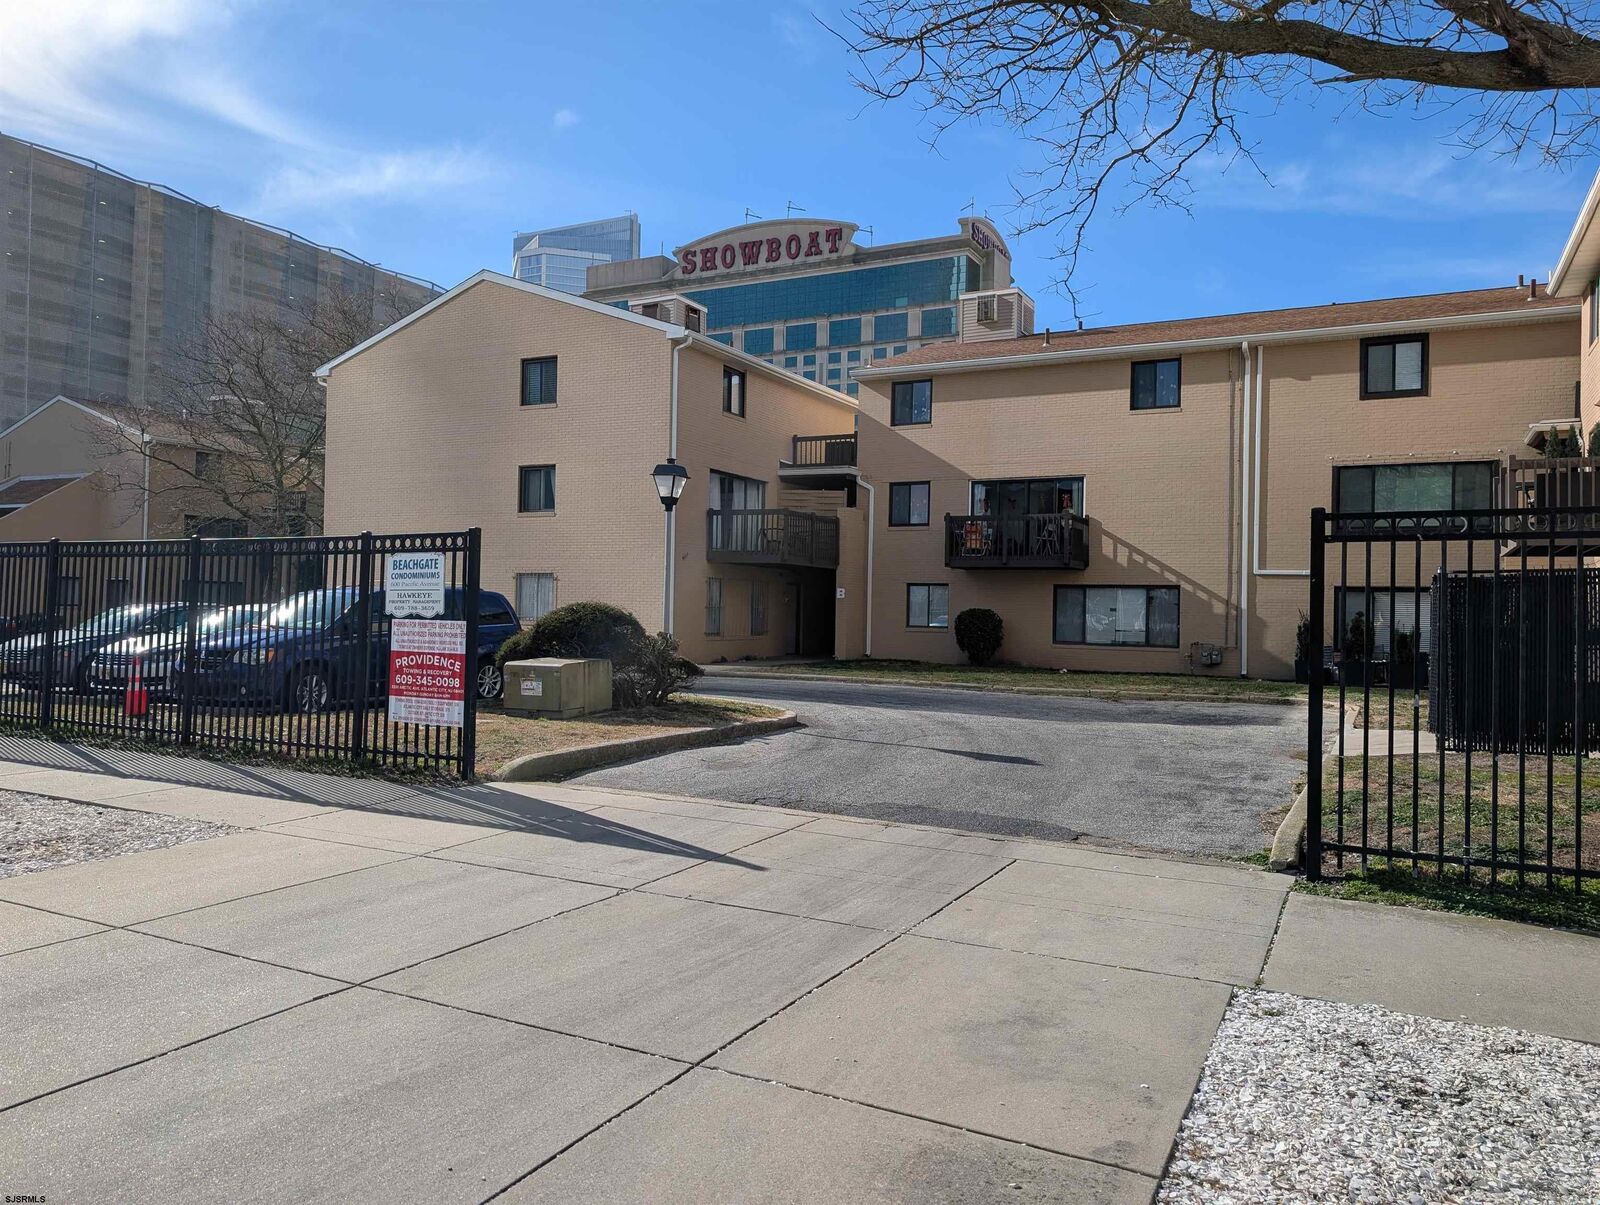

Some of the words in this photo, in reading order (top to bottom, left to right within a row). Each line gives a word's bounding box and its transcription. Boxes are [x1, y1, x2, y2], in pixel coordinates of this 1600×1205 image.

[682, 227, 843, 274] SHOWBOAT
[392, 558, 439, 571] BEACHGATE
[390, 571, 440, 580] CONDOMINIUMS
[395, 654, 462, 673] PROVIDENCE
[395, 674, 460, 688] 609-345-0098
